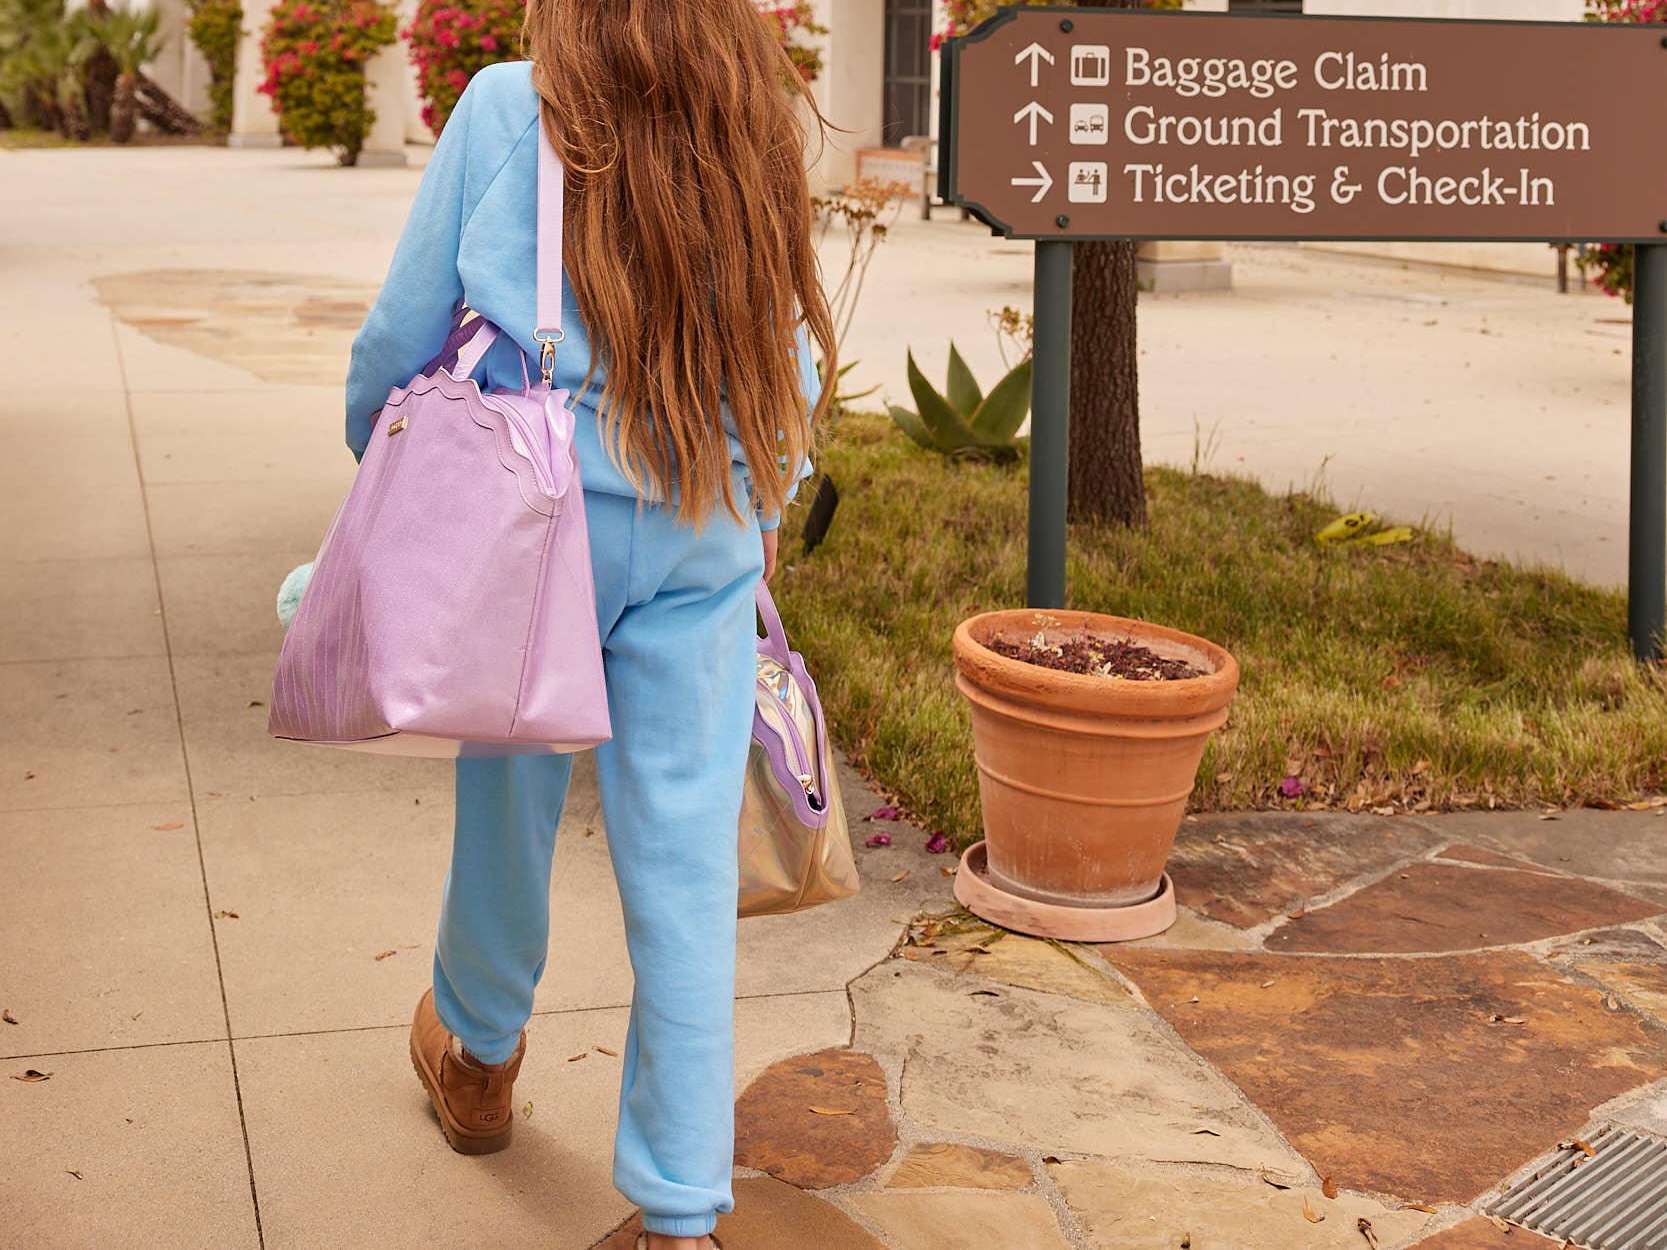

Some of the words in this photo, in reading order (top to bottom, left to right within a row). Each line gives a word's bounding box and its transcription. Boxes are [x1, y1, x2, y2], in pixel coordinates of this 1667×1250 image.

[1125, 47, 1298, 98] Baggage
[1314, 51, 1428, 91] Claim
[1124, 105, 1282, 146] Ground
[1298, 108, 1590, 156] Transportation
[1123, 163, 1316, 214] Ticketing
[1330, 165, 1362, 204] &
[1377, 166, 1555, 206] Check-In
